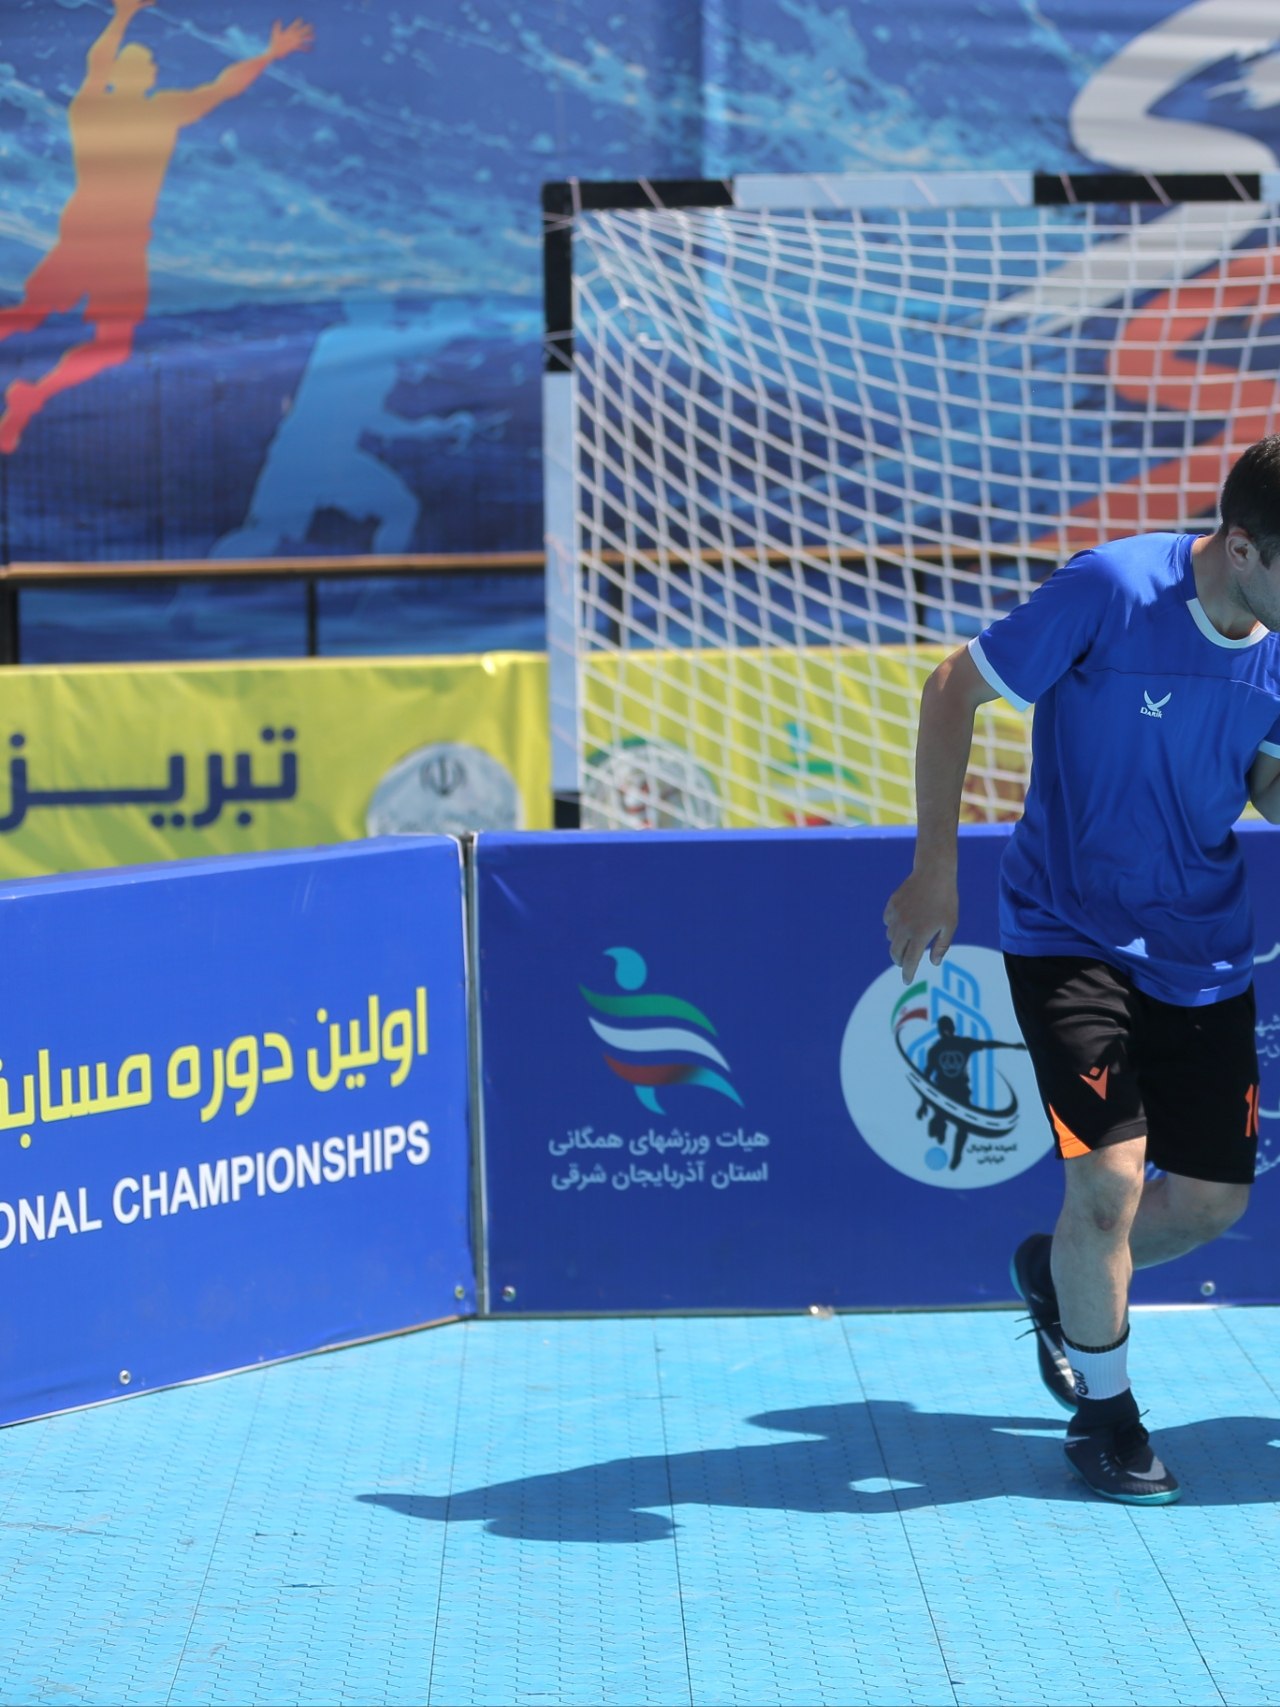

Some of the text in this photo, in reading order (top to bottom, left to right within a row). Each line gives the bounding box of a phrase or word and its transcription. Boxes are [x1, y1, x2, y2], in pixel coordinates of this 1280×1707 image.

[0, 986, 428, 1149] اولین دوره مساب
[549, 1127, 623, 1156] همگانی
[113, 1121, 431, 1224] CHAMPIONSHIPS
[551, 1163, 607, 1190] شرقی
[711, 1162, 768, 1189] استان
